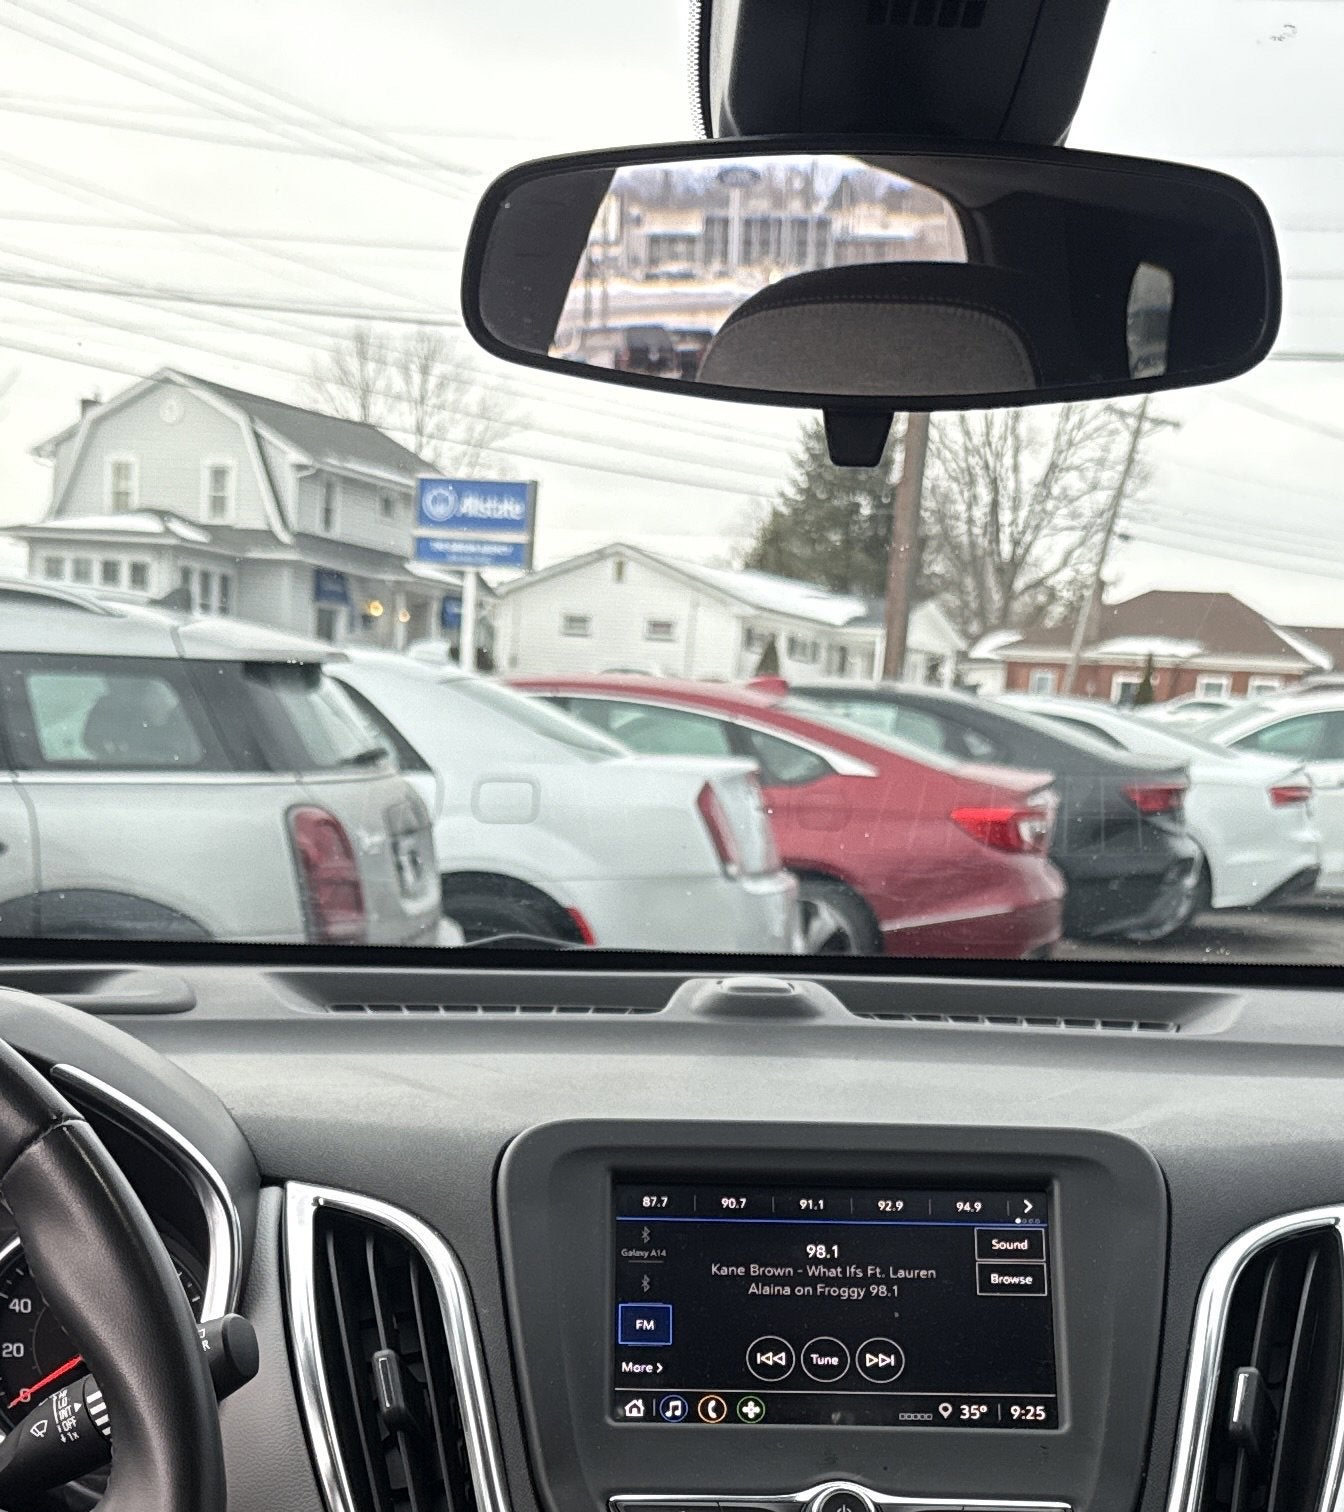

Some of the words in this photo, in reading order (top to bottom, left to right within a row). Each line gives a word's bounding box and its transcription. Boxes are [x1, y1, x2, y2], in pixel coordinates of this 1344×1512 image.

[643, 1196, 667, 1207] 87.7
[721, 1198, 746, 1208] 90.7
[800, 1200, 823, 1210] 91.1
[878, 1201, 903, 1211] 92.9
[957, 1202, 981, 1212] 94.9
[992, 1239, 1028, 1250] Sound
[651, 1248, 666, 1257] A14
[806, 1245, 839, 1259] 98.1
[712, 1264, 745, 1275] Kane
[750, 1264, 793, 1276] Brown
[807, 1265, 842, 1277] What
[847, 1265, 863, 1277] Ifs
[868, 1266, 885, 1277] Ft.
[890, 1267, 936, 1278] Lauren
[991, 1274, 1032, 1284] Browse
[748, 1283, 790, 1295] Alaina
[795, 1287, 812, 1295] on
[817, 1284, 865, 1299] Froggy
[870, 1285, 897, 1296] 98.1
[9, 1297, 32, 1313] 40
[636, 1320, 654, 1330] FM
[3, 1343, 24, 1357] 20
[811, 1354, 838, 1365] Tune
[622, 1362, 653, 1372] More
[960, 1405, 987, 1419] 35°
[1011, 1406, 1045, 1420] 9:25
